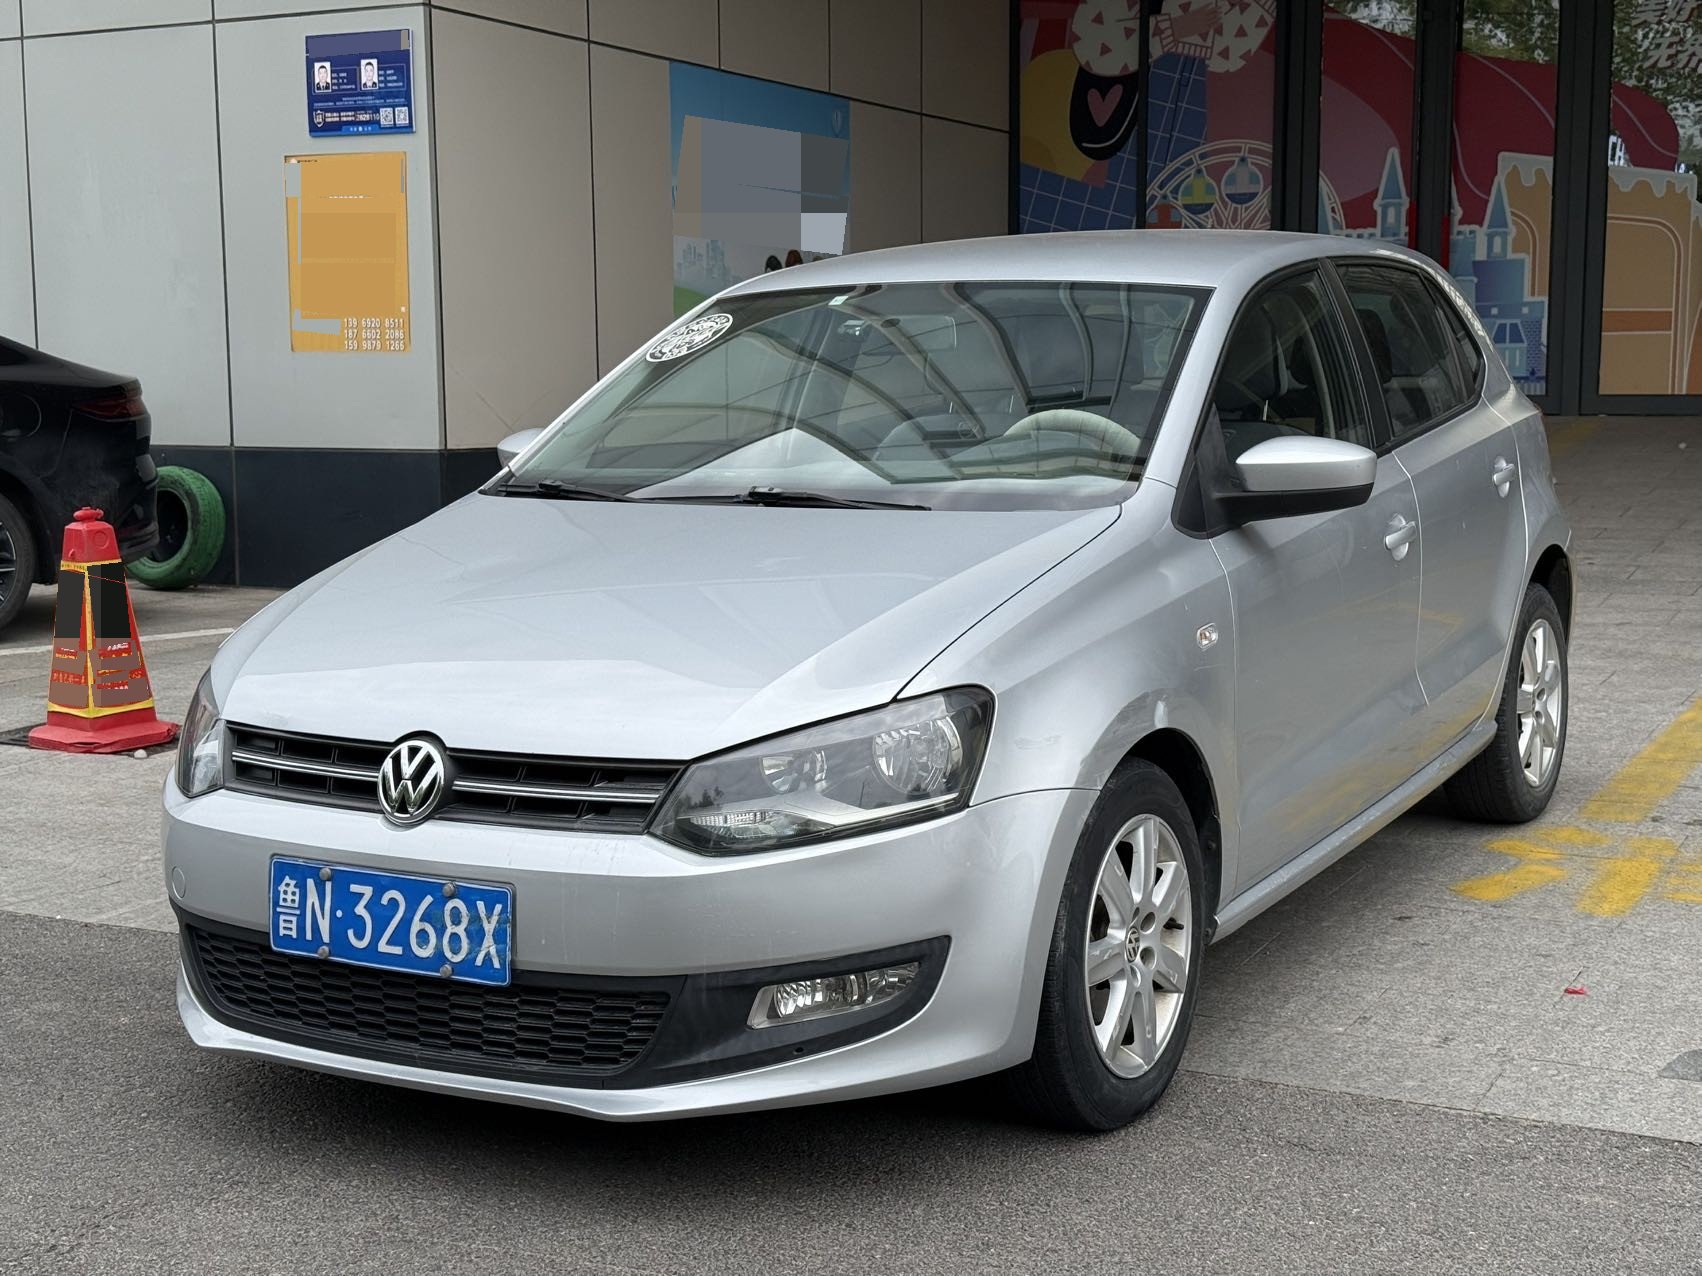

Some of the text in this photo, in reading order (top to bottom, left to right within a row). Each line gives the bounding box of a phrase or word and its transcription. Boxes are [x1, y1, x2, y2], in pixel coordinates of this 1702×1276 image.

[344, 317, 403, 328] 139 6920 8511
[344, 328, 358, 339] 187
[344, 339, 358, 350] 159
